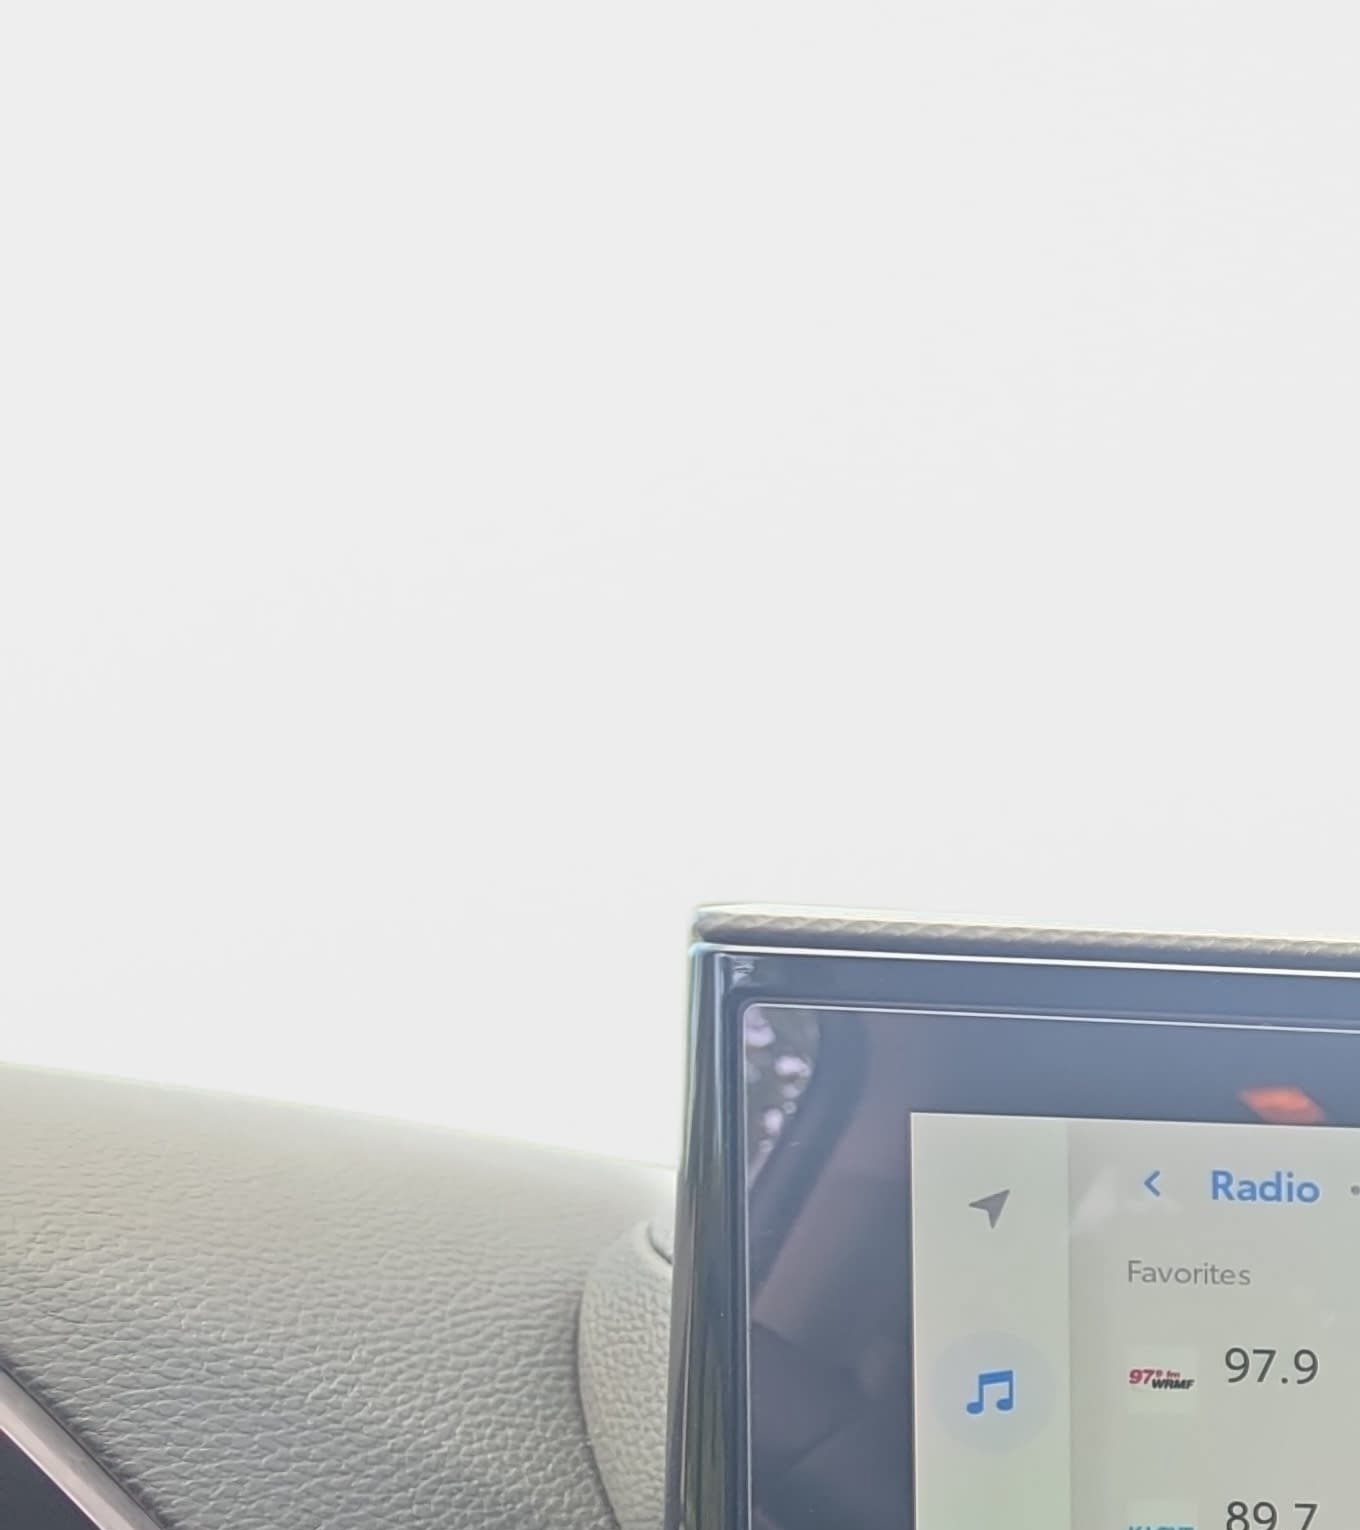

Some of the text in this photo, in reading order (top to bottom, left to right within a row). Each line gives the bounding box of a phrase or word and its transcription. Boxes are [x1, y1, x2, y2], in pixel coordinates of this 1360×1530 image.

[1210, 1170, 1321, 1204] Radio
[1127, 1260, 1251, 1287] Favorites
[1224, 1346, 1320, 1387] 97.9
